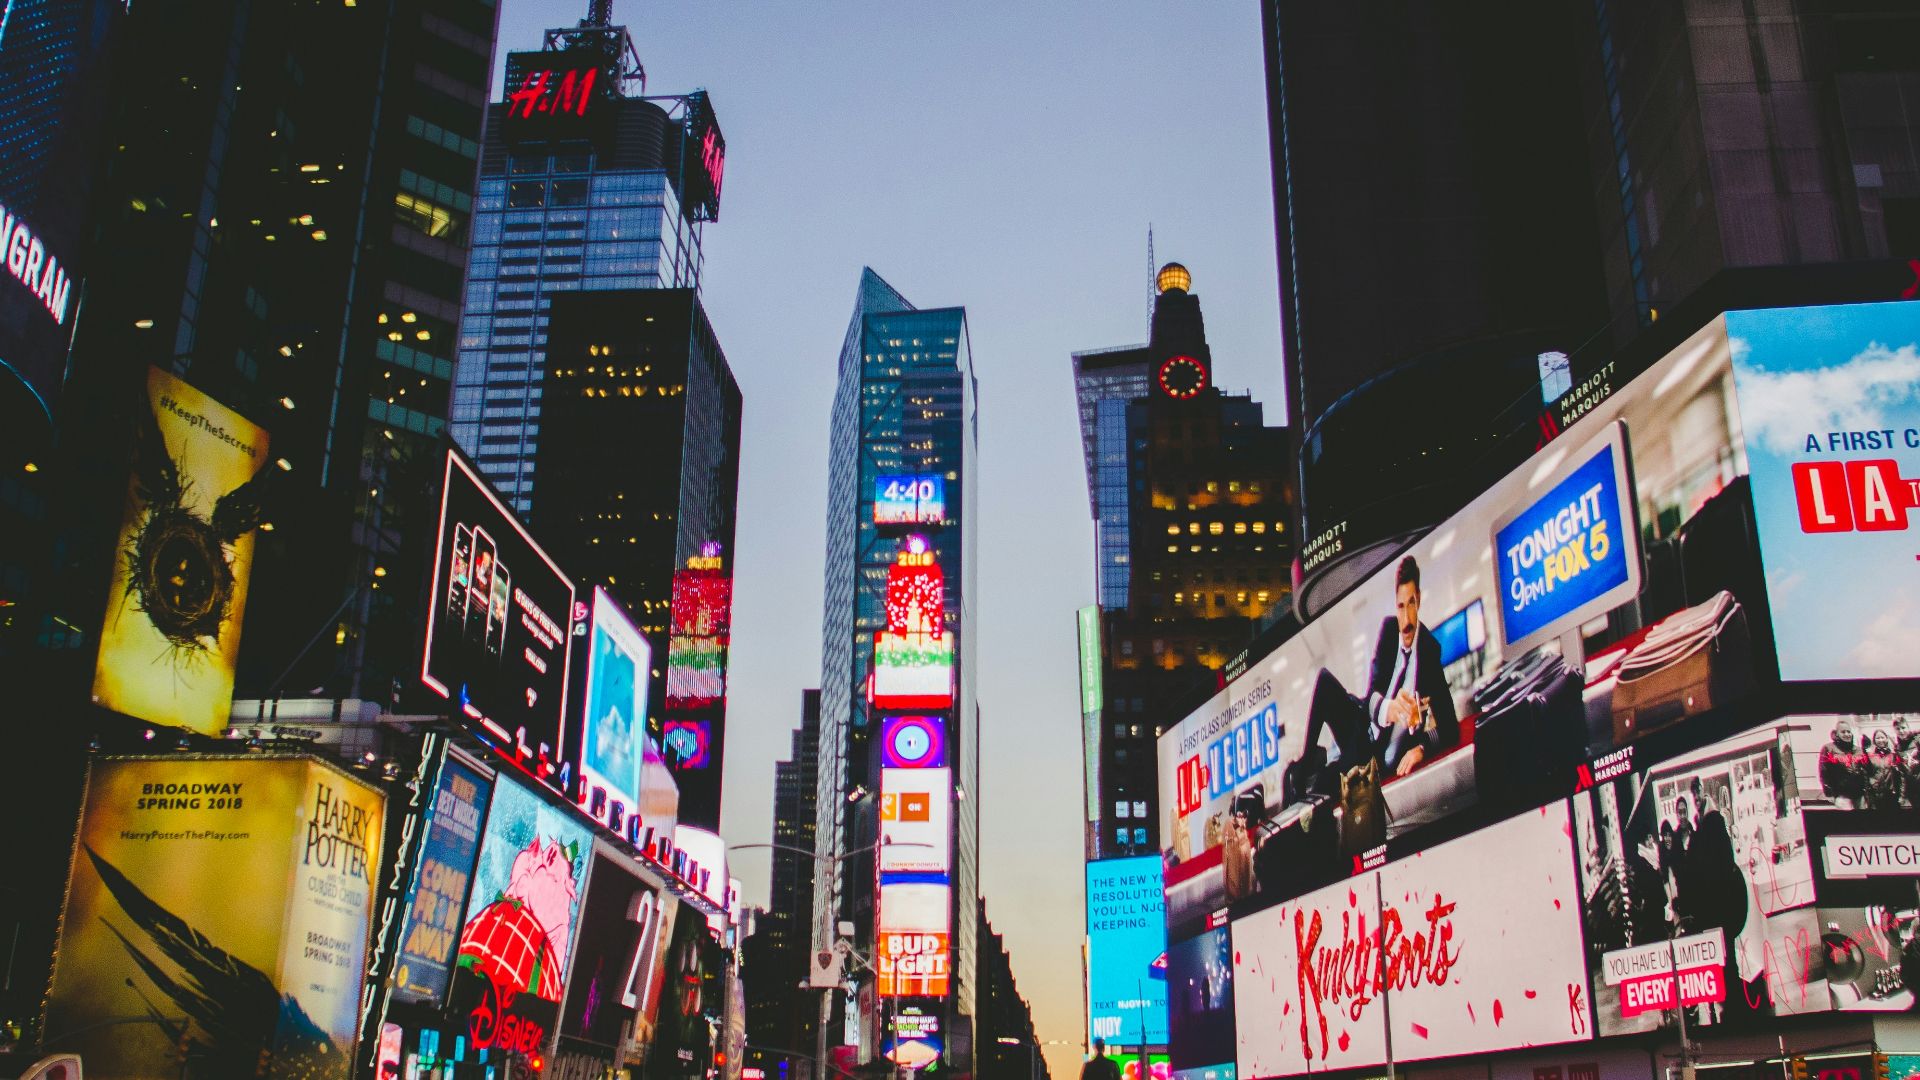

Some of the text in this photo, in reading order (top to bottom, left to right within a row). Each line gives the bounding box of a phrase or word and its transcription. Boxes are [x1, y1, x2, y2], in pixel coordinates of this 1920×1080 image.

[1561, 361, 1615, 411] MARRIOTT
[1562, 383, 1611, 427] MARQUIS
[160, 395, 257, 458] #KeepTheSecrets
[1805, 428, 1920, 452] A FIRST C
[884, 480, 935, 501] 4:40
[1809, 465, 1920, 525] LA T
[1303, 521, 1347, 558] MARRIOTT
[1507, 482, 1603, 576] TONIGHT
[898, 551, 934, 566] 2018
[1304, 540, 1343, 573] MARQUIS
[1543, 532, 1591, 593] FOX
[1590, 519, 1610, 561] 5
[1225, 649, 1249, 672] MARRIOTT
[1225, 664, 1247, 682] MARQUIS
[1178, 679, 1273, 757] A FIRST CLASS COMEDY SERIES
[1180, 760, 1200, 812] LA
[1210, 707, 1277, 795] VEGAS
[1593, 746, 1634, 770] MARRIOTT
[1595, 760, 1631, 782] MARQUIS
[142, 783, 242, 795] BROADWAY
[137, 797, 243, 810] SPRING 2018
[314, 783, 374, 846] HARRY
[120, 830, 250, 842] HarryPotterThePlay.com
[590, 785, 711, 894] BROADWAY
[304, 820, 370, 885] POTTER
[1362, 844, 1388, 861] MARRIOTT
[1363, 855, 1387, 870] MARQUIS
[1093, 877, 1115, 888] THE
[1120, 874, 1146, 886] NEW
[1093, 888, 1162, 902] RESOLUTIO
[1093, 905, 1136, 916] YOU'LL
[307, 931, 352, 953] BROADWAY
[404, 922, 456, 963] AWAY
[887, 935, 940, 954] BUD
[304, 946, 333, 964] SPRING
[880, 953, 947, 974] LIGHT
[1610, 941, 1717, 976] YOU HAVE UNIMITED
[1294, 893, 1465, 1061] Kinky Boots
[1095, 1001, 1115, 1009] TEXT
[1093, 1016, 1122, 1040] NJOY
